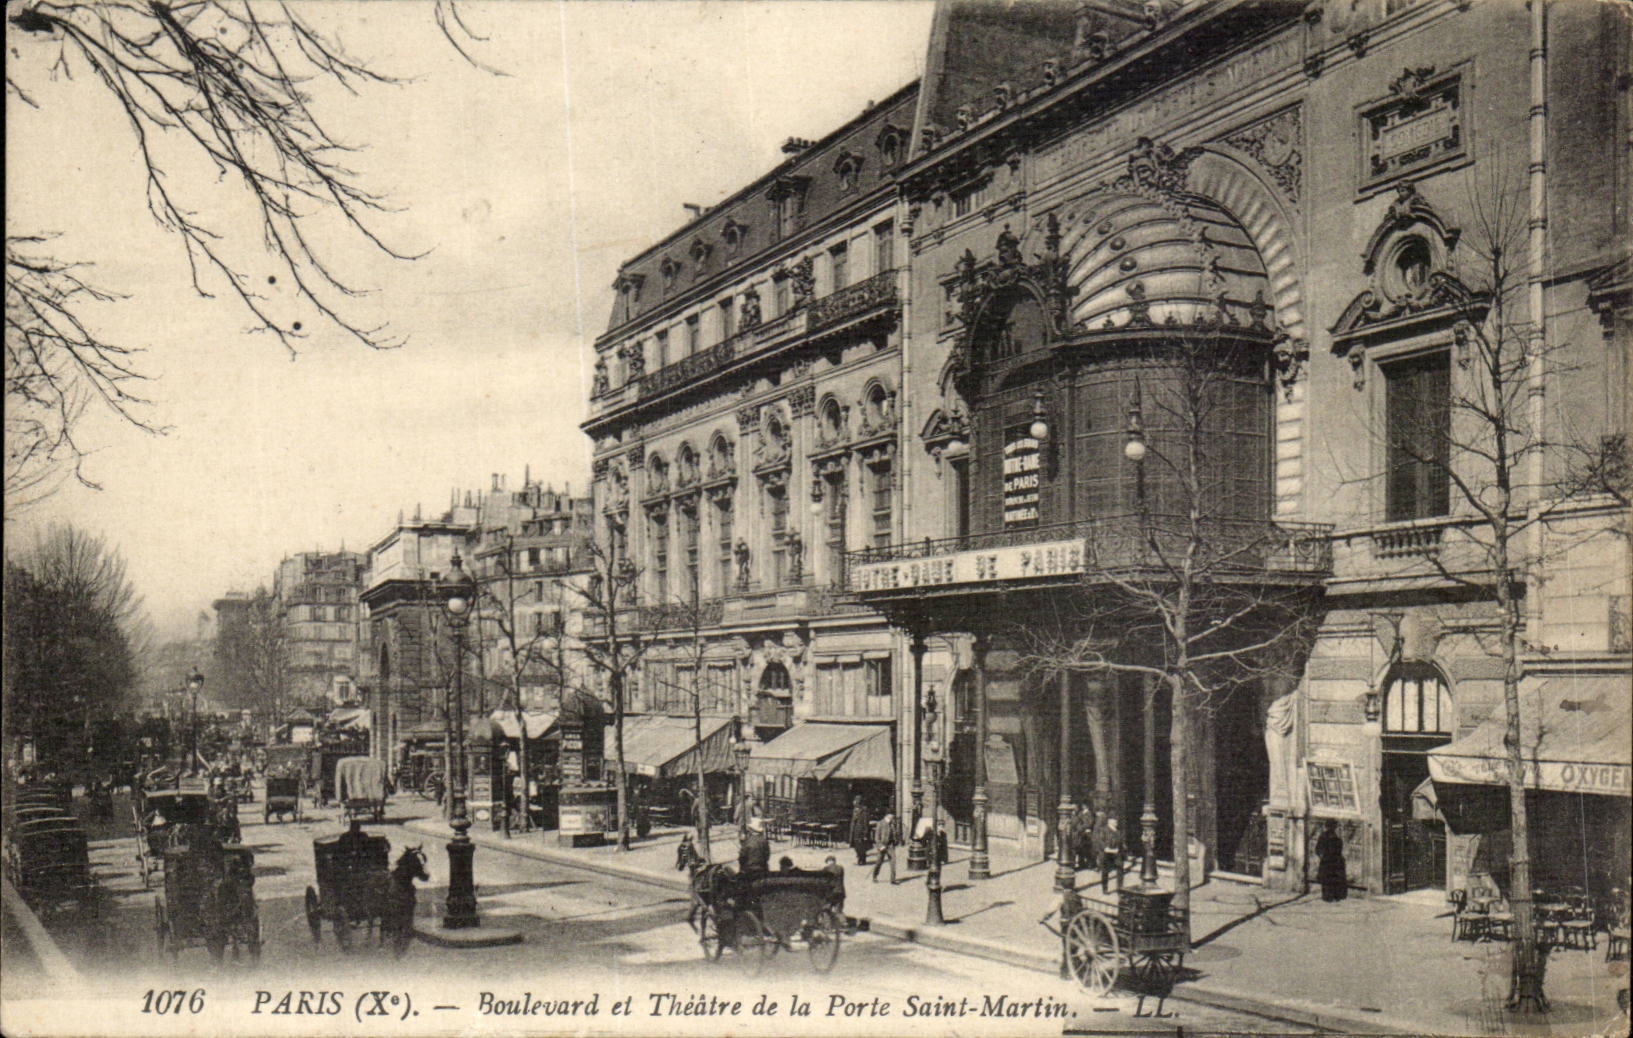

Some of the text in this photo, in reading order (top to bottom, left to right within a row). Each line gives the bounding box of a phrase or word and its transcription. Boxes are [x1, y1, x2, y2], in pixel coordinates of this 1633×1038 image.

[1013, 474, 1039, 491] PARIS
[975, 554, 998, 579] DE
[1020, 546, 1081, 577] PARIS
